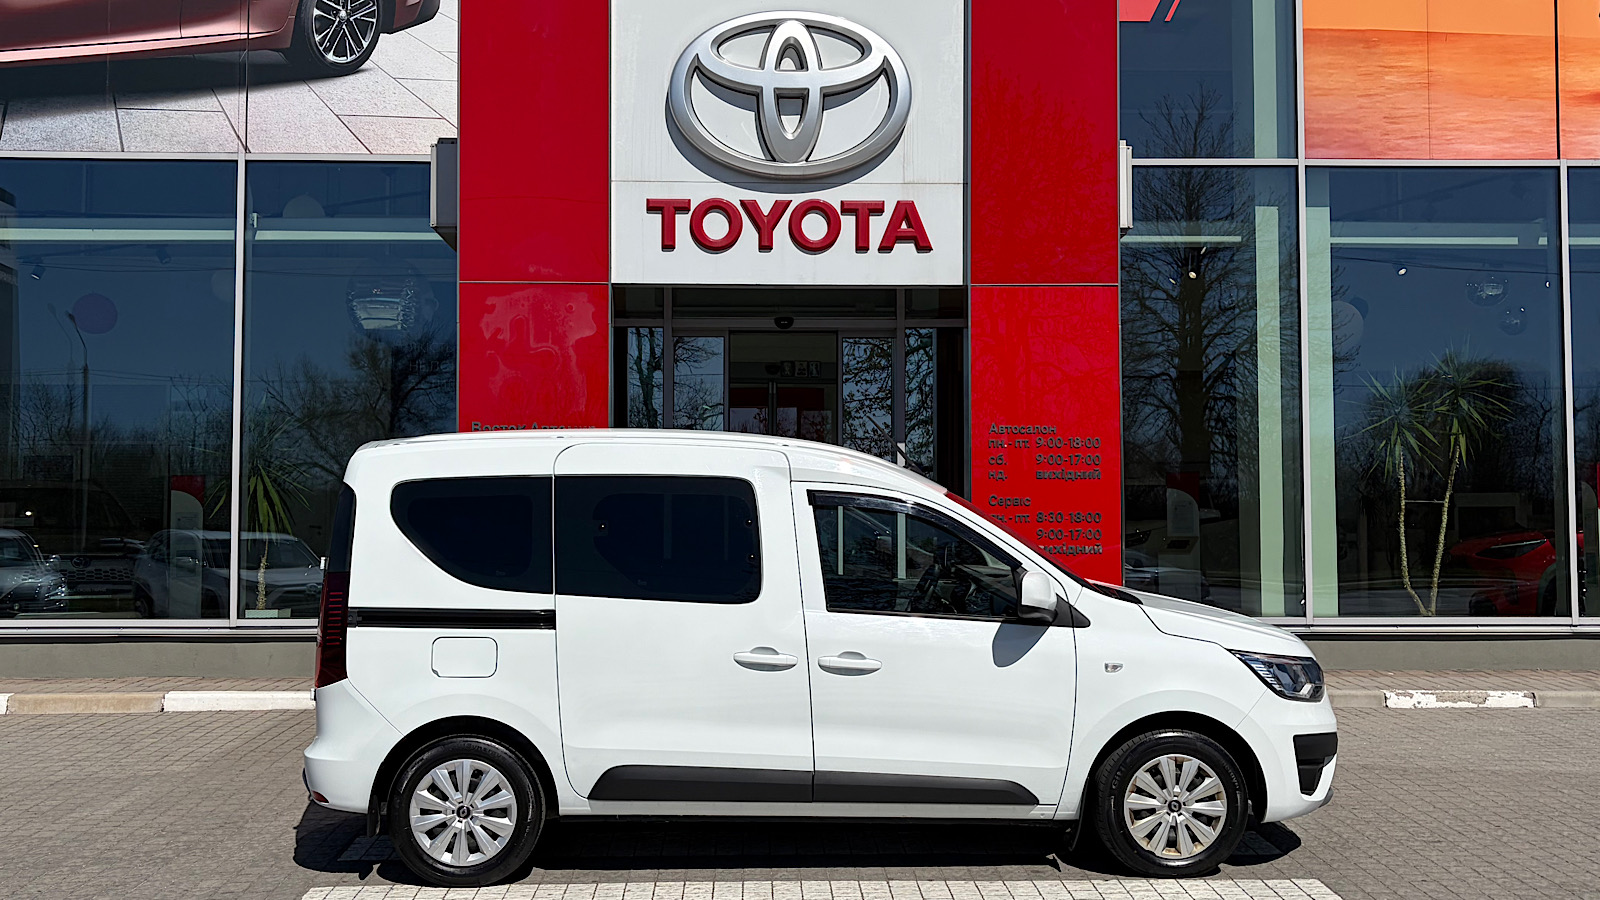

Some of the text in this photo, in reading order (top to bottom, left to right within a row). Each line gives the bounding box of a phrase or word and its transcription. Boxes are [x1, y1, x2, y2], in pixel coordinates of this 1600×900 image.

[646, 198, 933, 255] TOYOTA
[988, 423, 1057, 434] Автосалон
[1036, 437, 1101, 449] 9:00-18:00
[988, 454, 1101, 466] сб. 9:00-17:00
[988, 468, 1101, 481] нд. вихідний
[988, 495, 1031, 508] Сервіс
[1036, 512, 1102, 524] 8:30-18:00
[1036, 529, 1102, 541] 9:00-17:00
[1039, 543, 1103, 555] ихідний
